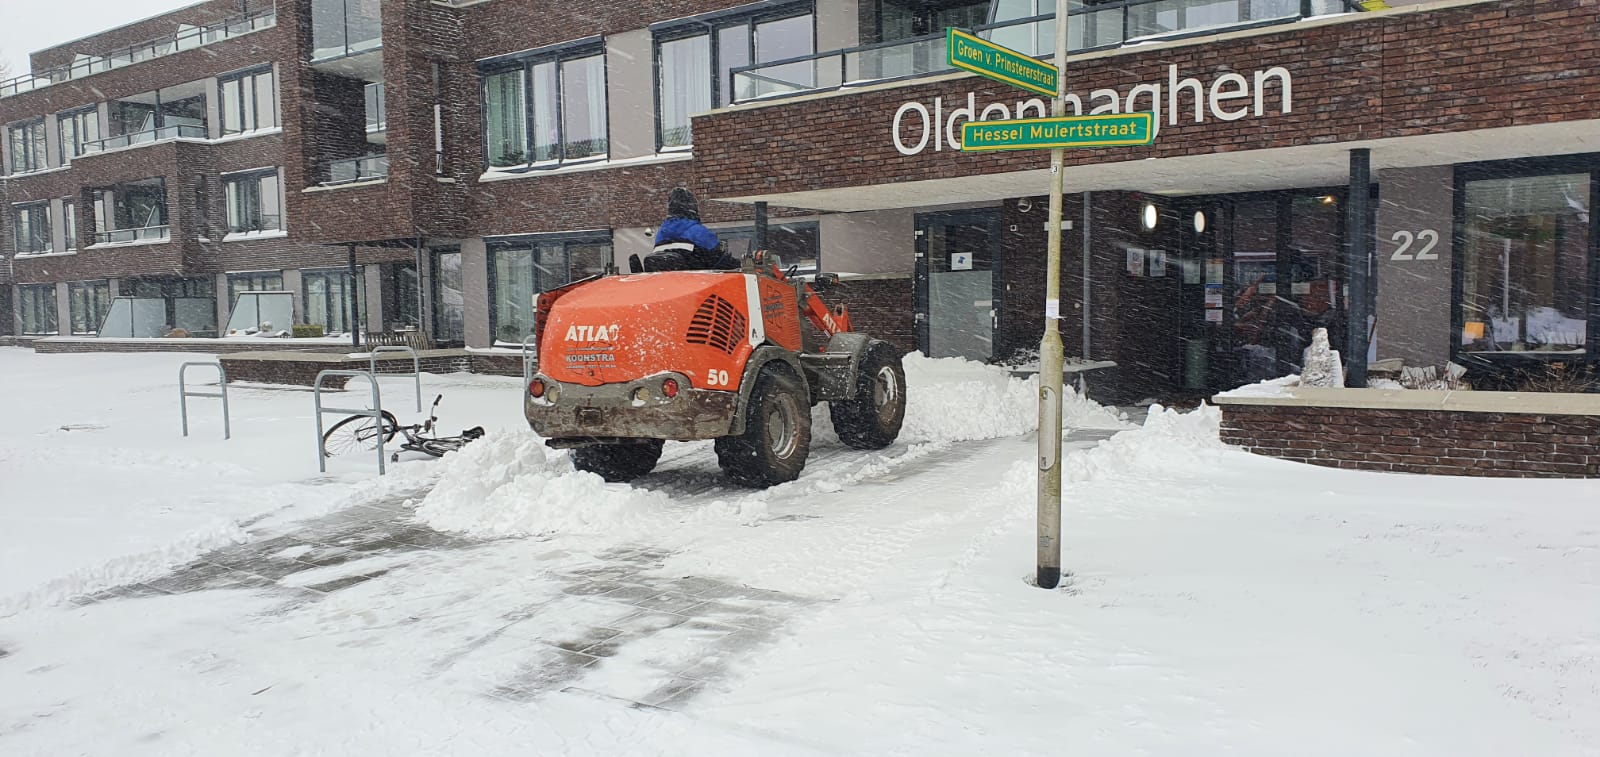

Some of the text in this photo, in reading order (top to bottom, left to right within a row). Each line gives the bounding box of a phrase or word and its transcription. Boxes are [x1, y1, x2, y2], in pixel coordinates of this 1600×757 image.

[957, 39, 1055, 87] Groen v. Prinstererstraat
[892, 64, 1292, 155] Oldaghen
[973, 121, 1137, 142] Hessel Mulertstraat
[1390, 229, 1439, 261] 22
[707, 368, 729, 386] 50
